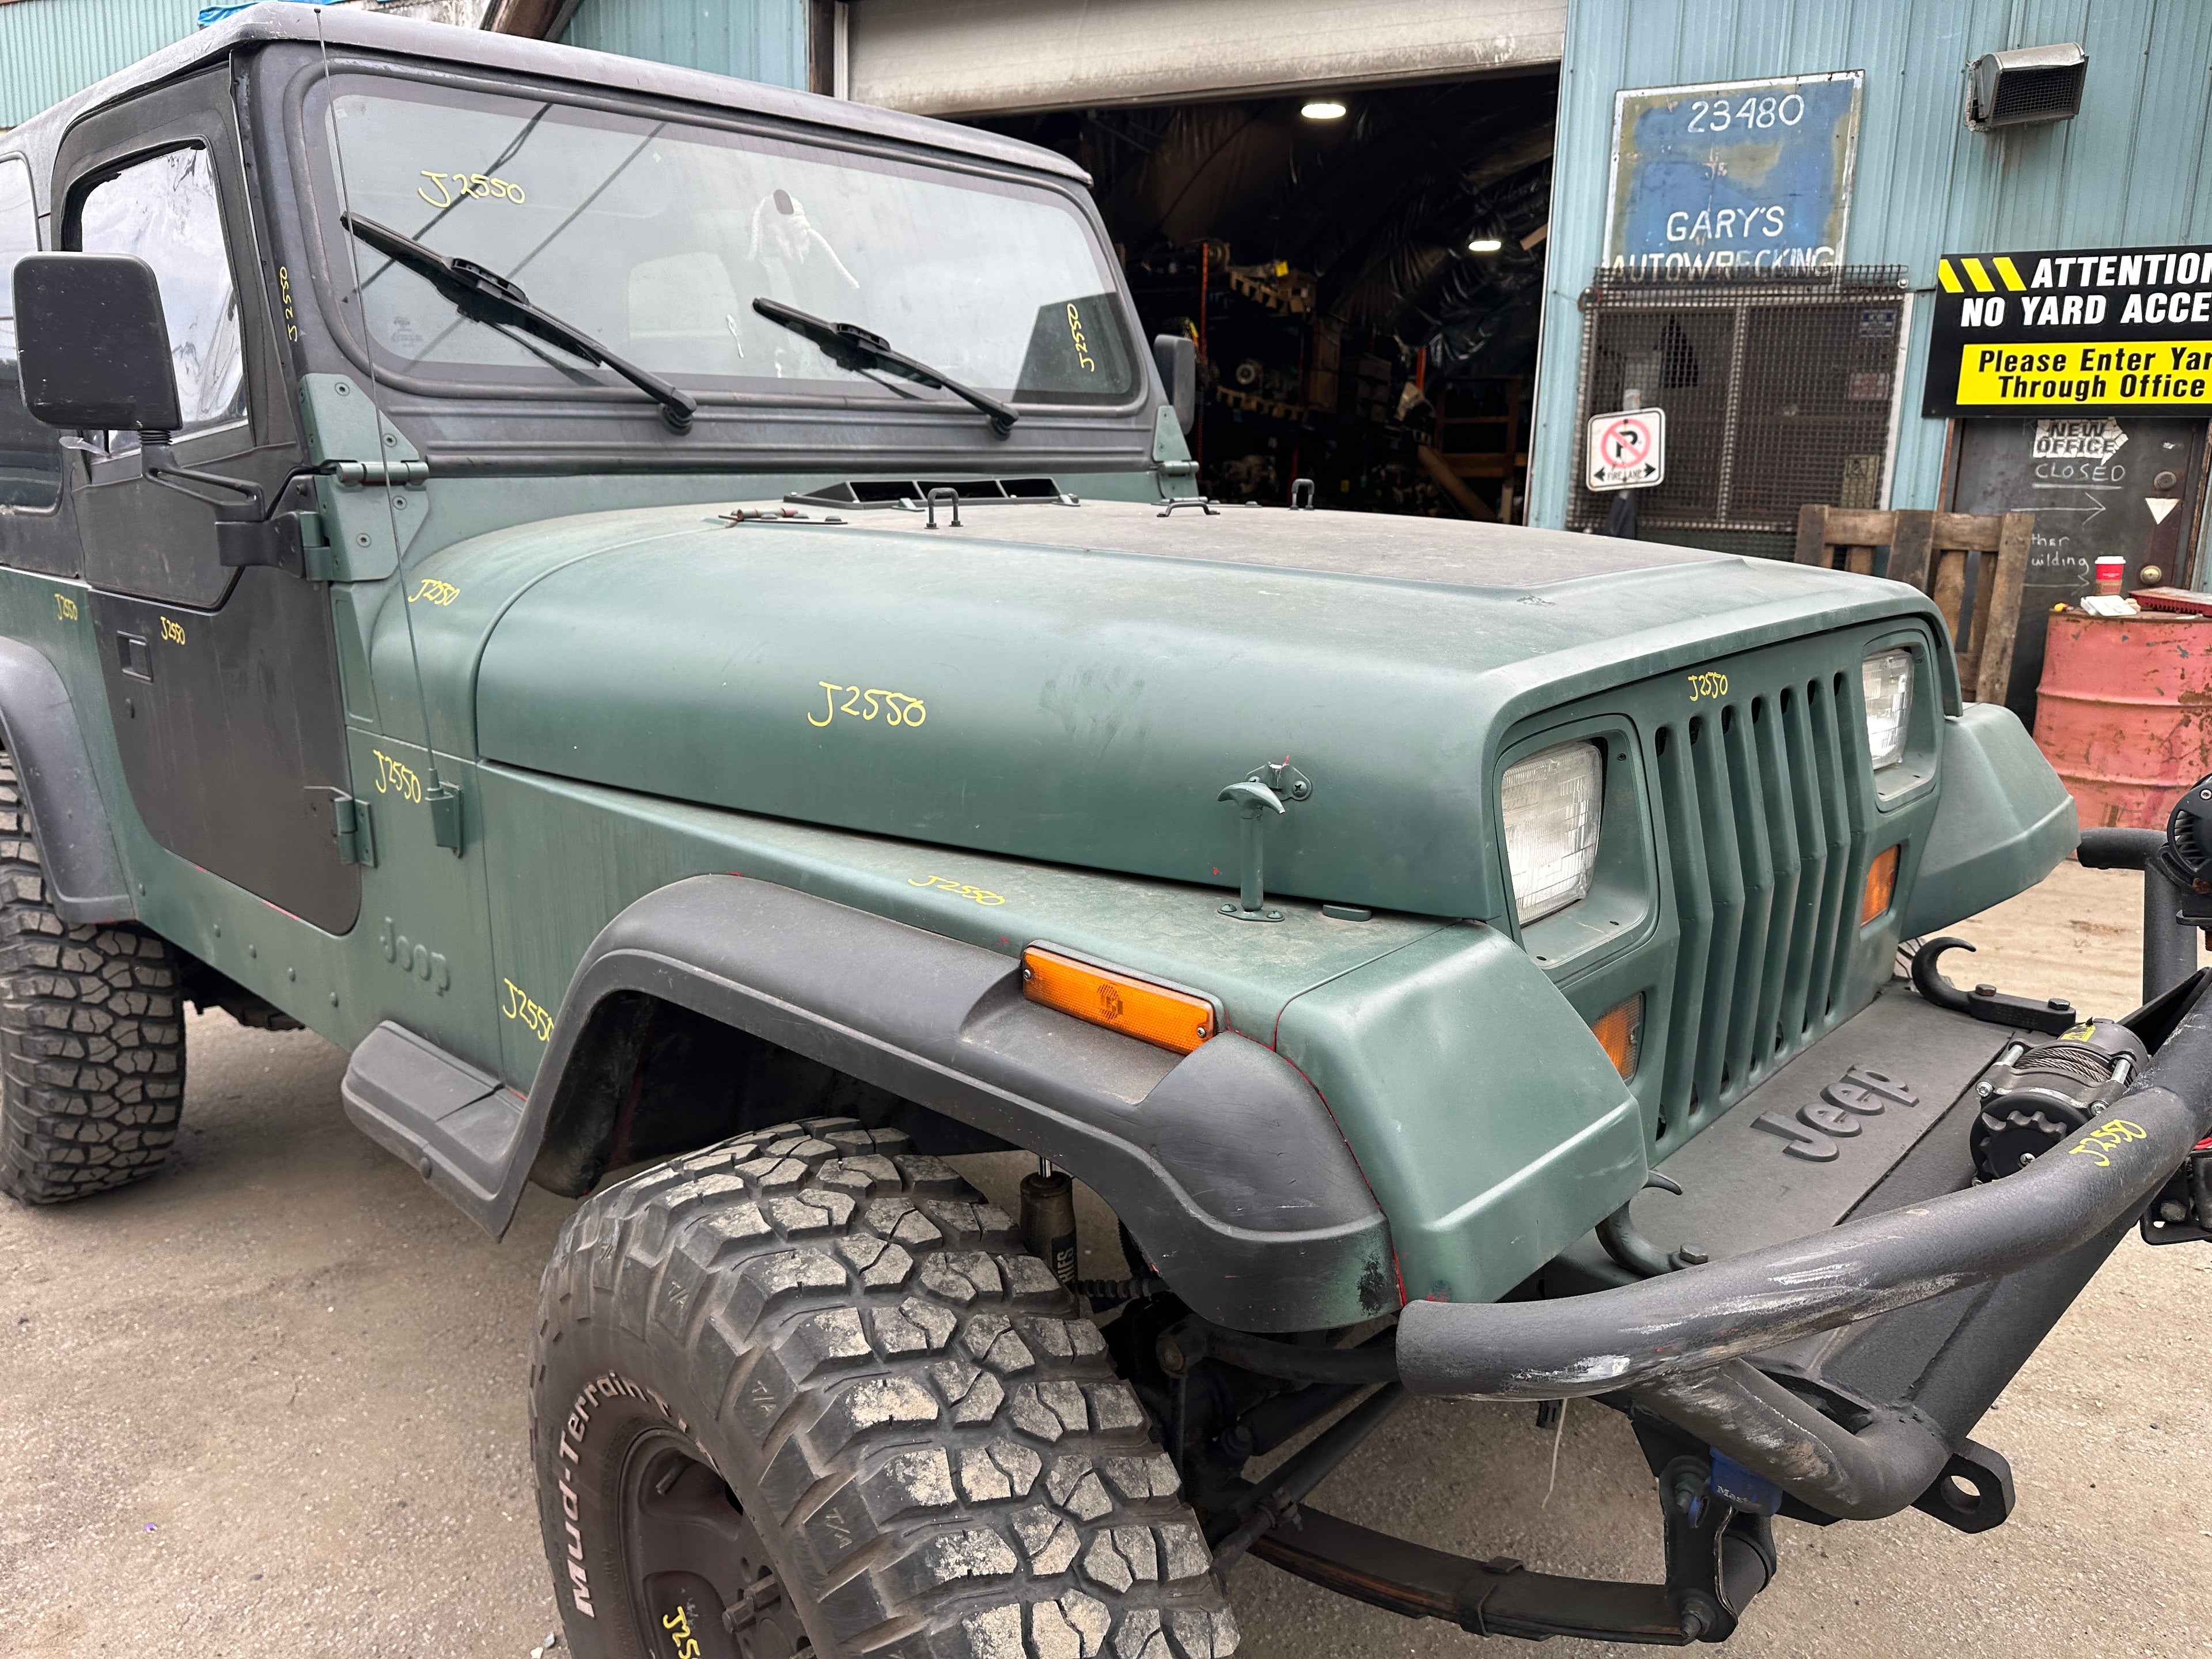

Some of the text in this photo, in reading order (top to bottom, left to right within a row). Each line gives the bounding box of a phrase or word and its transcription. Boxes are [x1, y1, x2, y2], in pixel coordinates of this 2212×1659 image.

[1687, 94, 1805, 133] 23480
[418, 171, 525, 208] J2550
[1666, 205, 1785, 242] GARY'S
[280, 266, 298, 342] J2550
[1961, 296, 2005, 327] NO
[2021, 294, 2107, 326] YARD
[1067, 303, 1094, 372] J2550
[1978, 350, 2067, 373] Please
[2080, 348, 2156, 372] Enter
[1998, 374, 2206, 402] Through Office
[2037, 436, 2116, 453] OFFICE
[2051, 423, 2105, 437] NEW
[2035, 462, 2126, 482] CLOSED
[407, 579, 460, 606] J2550
[808, 681, 926, 727] J2550
[1688, 672, 1728, 702] J2550
[373, 749, 421, 804] J2550
[907, 875, 1006, 906] J2550
[1749, 1063, 1920, 1162] Jeep
[2069, 1119, 2147, 1167] J2550
[558, 1370, 649, 1619] Mud-Terrain
